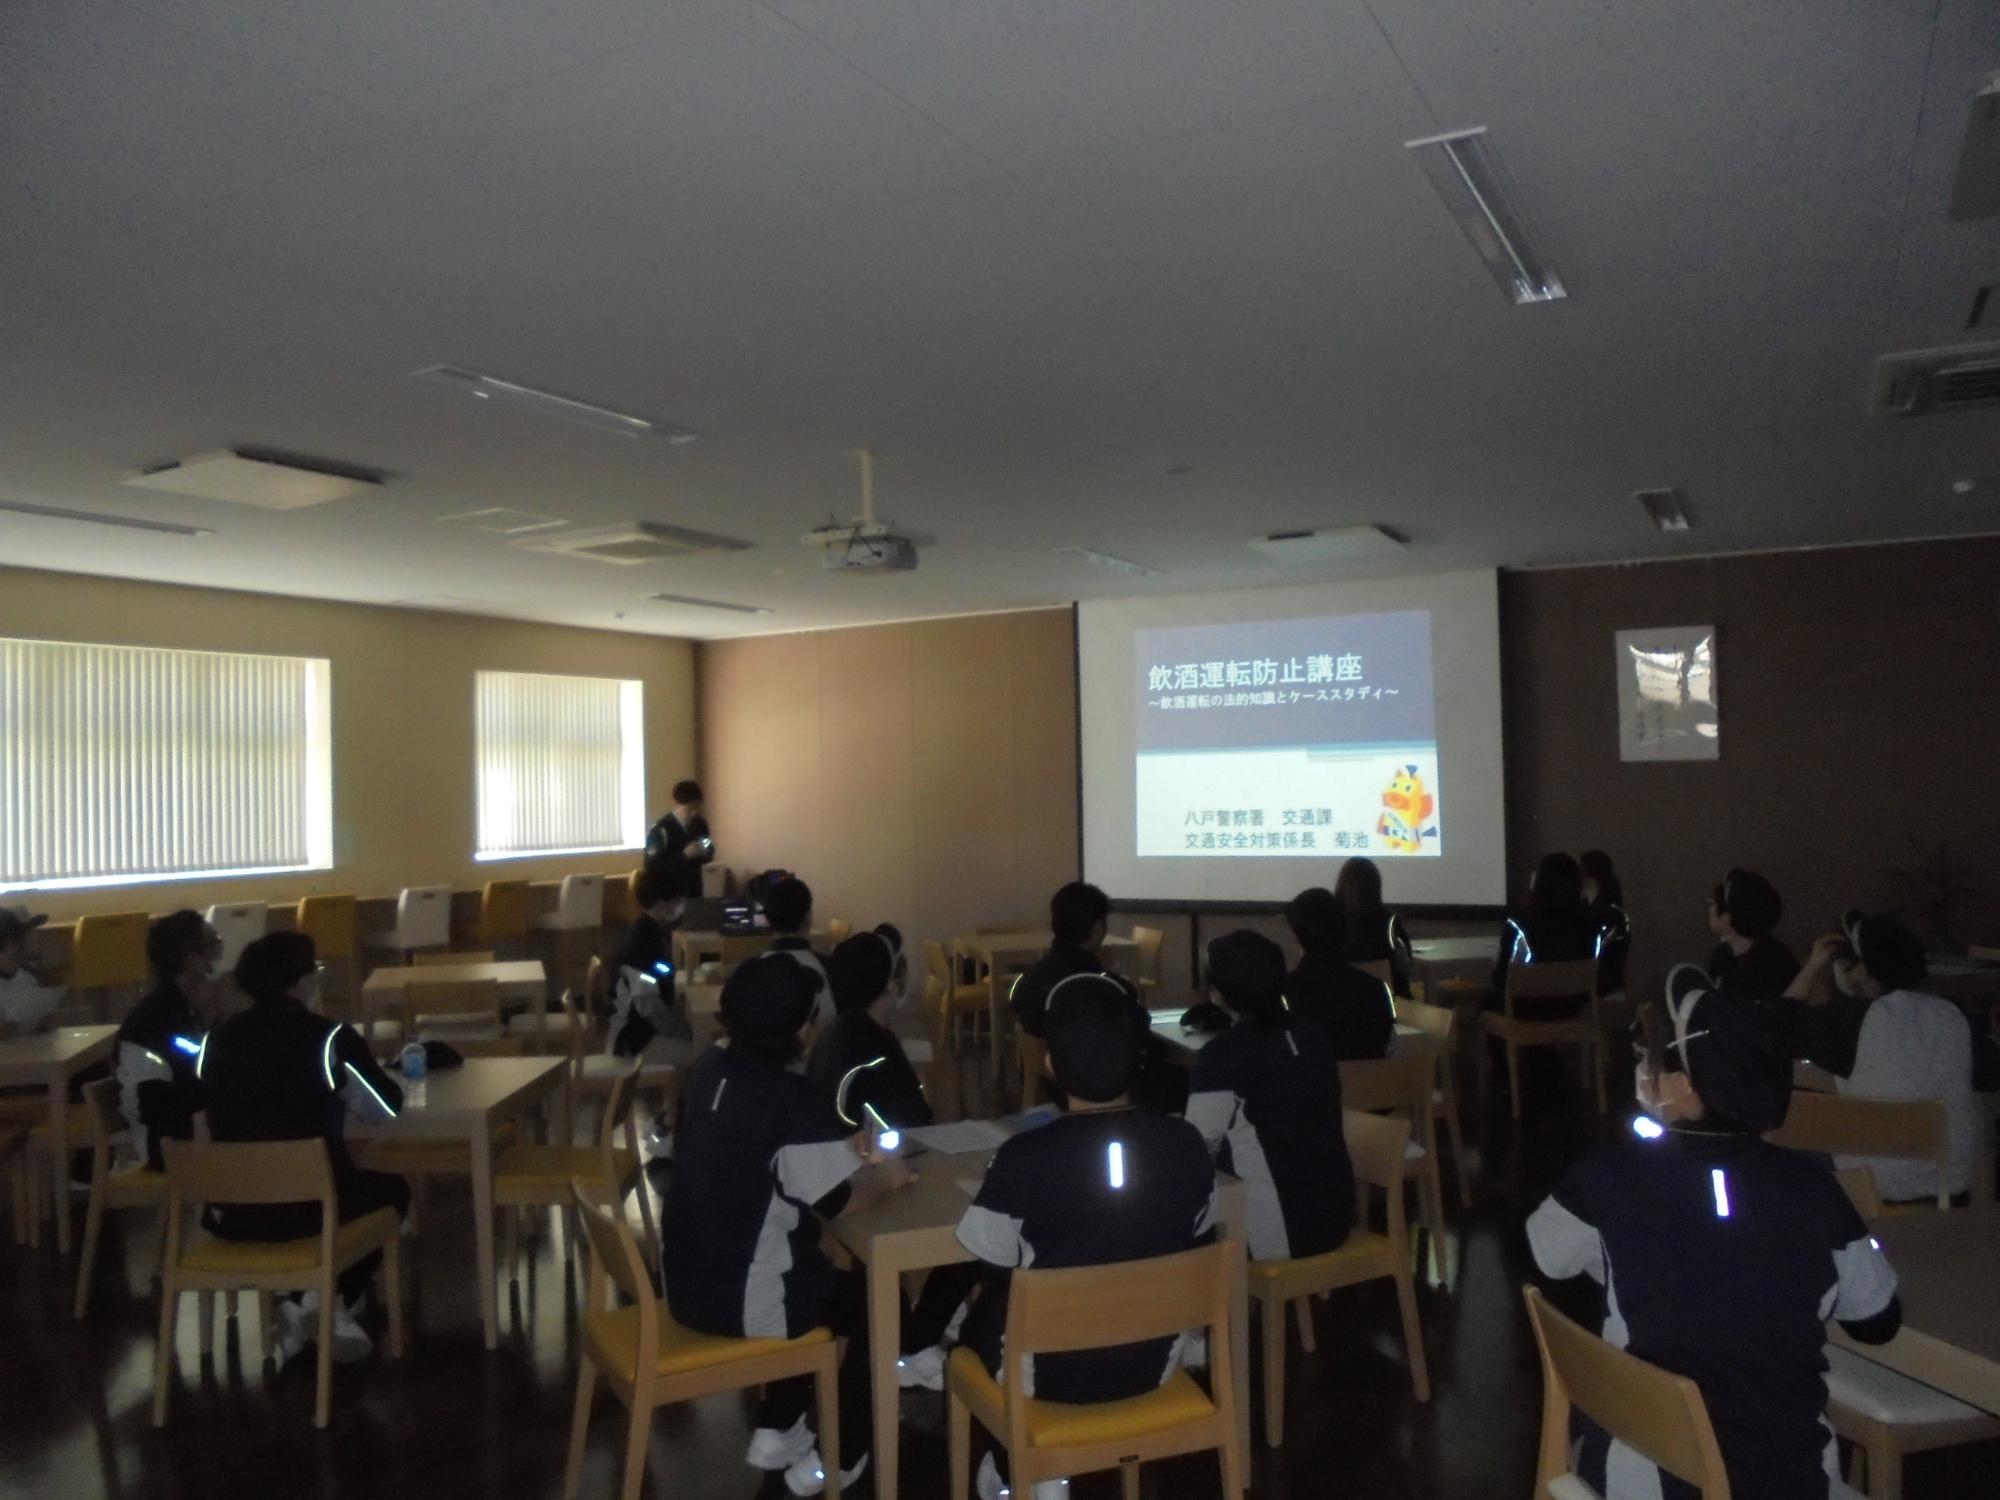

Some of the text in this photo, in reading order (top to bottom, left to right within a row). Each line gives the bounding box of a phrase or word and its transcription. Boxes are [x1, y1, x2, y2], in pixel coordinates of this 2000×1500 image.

[1149, 653, 1363, 690] 飲酒運転防止講座
[1184, 808, 1333, 826] 八戸警察署 交通課
[1184, 831, 1369, 849] 交通安全対策係長 菊池
